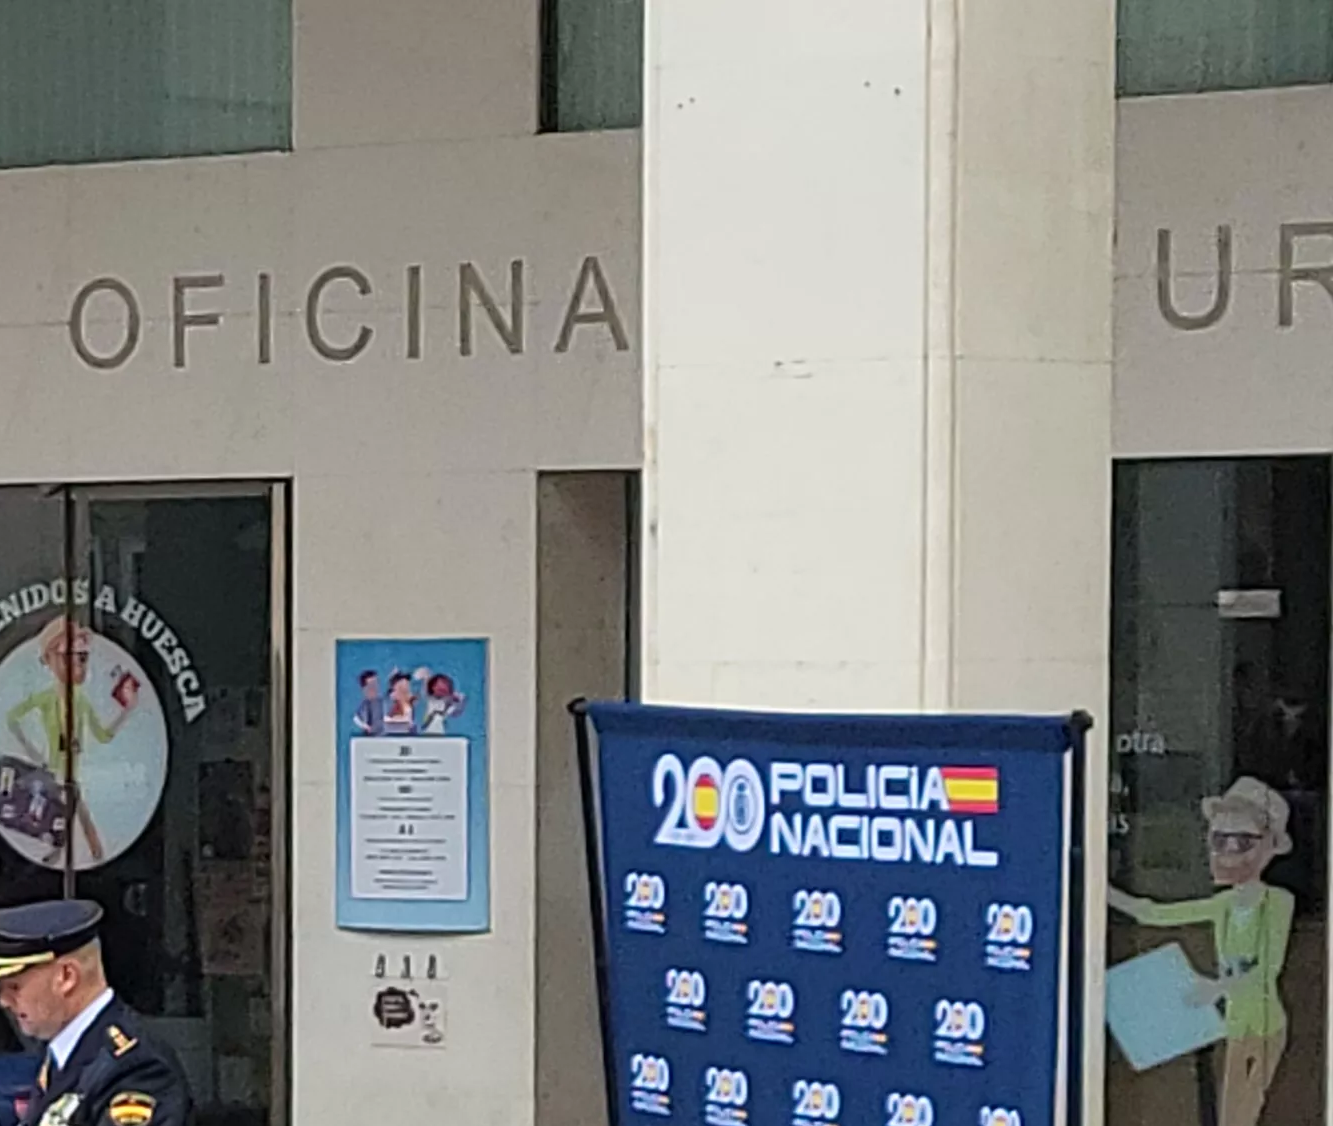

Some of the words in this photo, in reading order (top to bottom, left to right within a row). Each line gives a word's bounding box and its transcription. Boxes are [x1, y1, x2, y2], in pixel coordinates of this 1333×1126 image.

[69, 256, 630, 369] OFICINA
[94, 585, 116, 613] A
[121, 597, 207, 723] HUESCA
[653, 753, 765, 852] 200
[770, 812, 998, 866] NACIONAL
